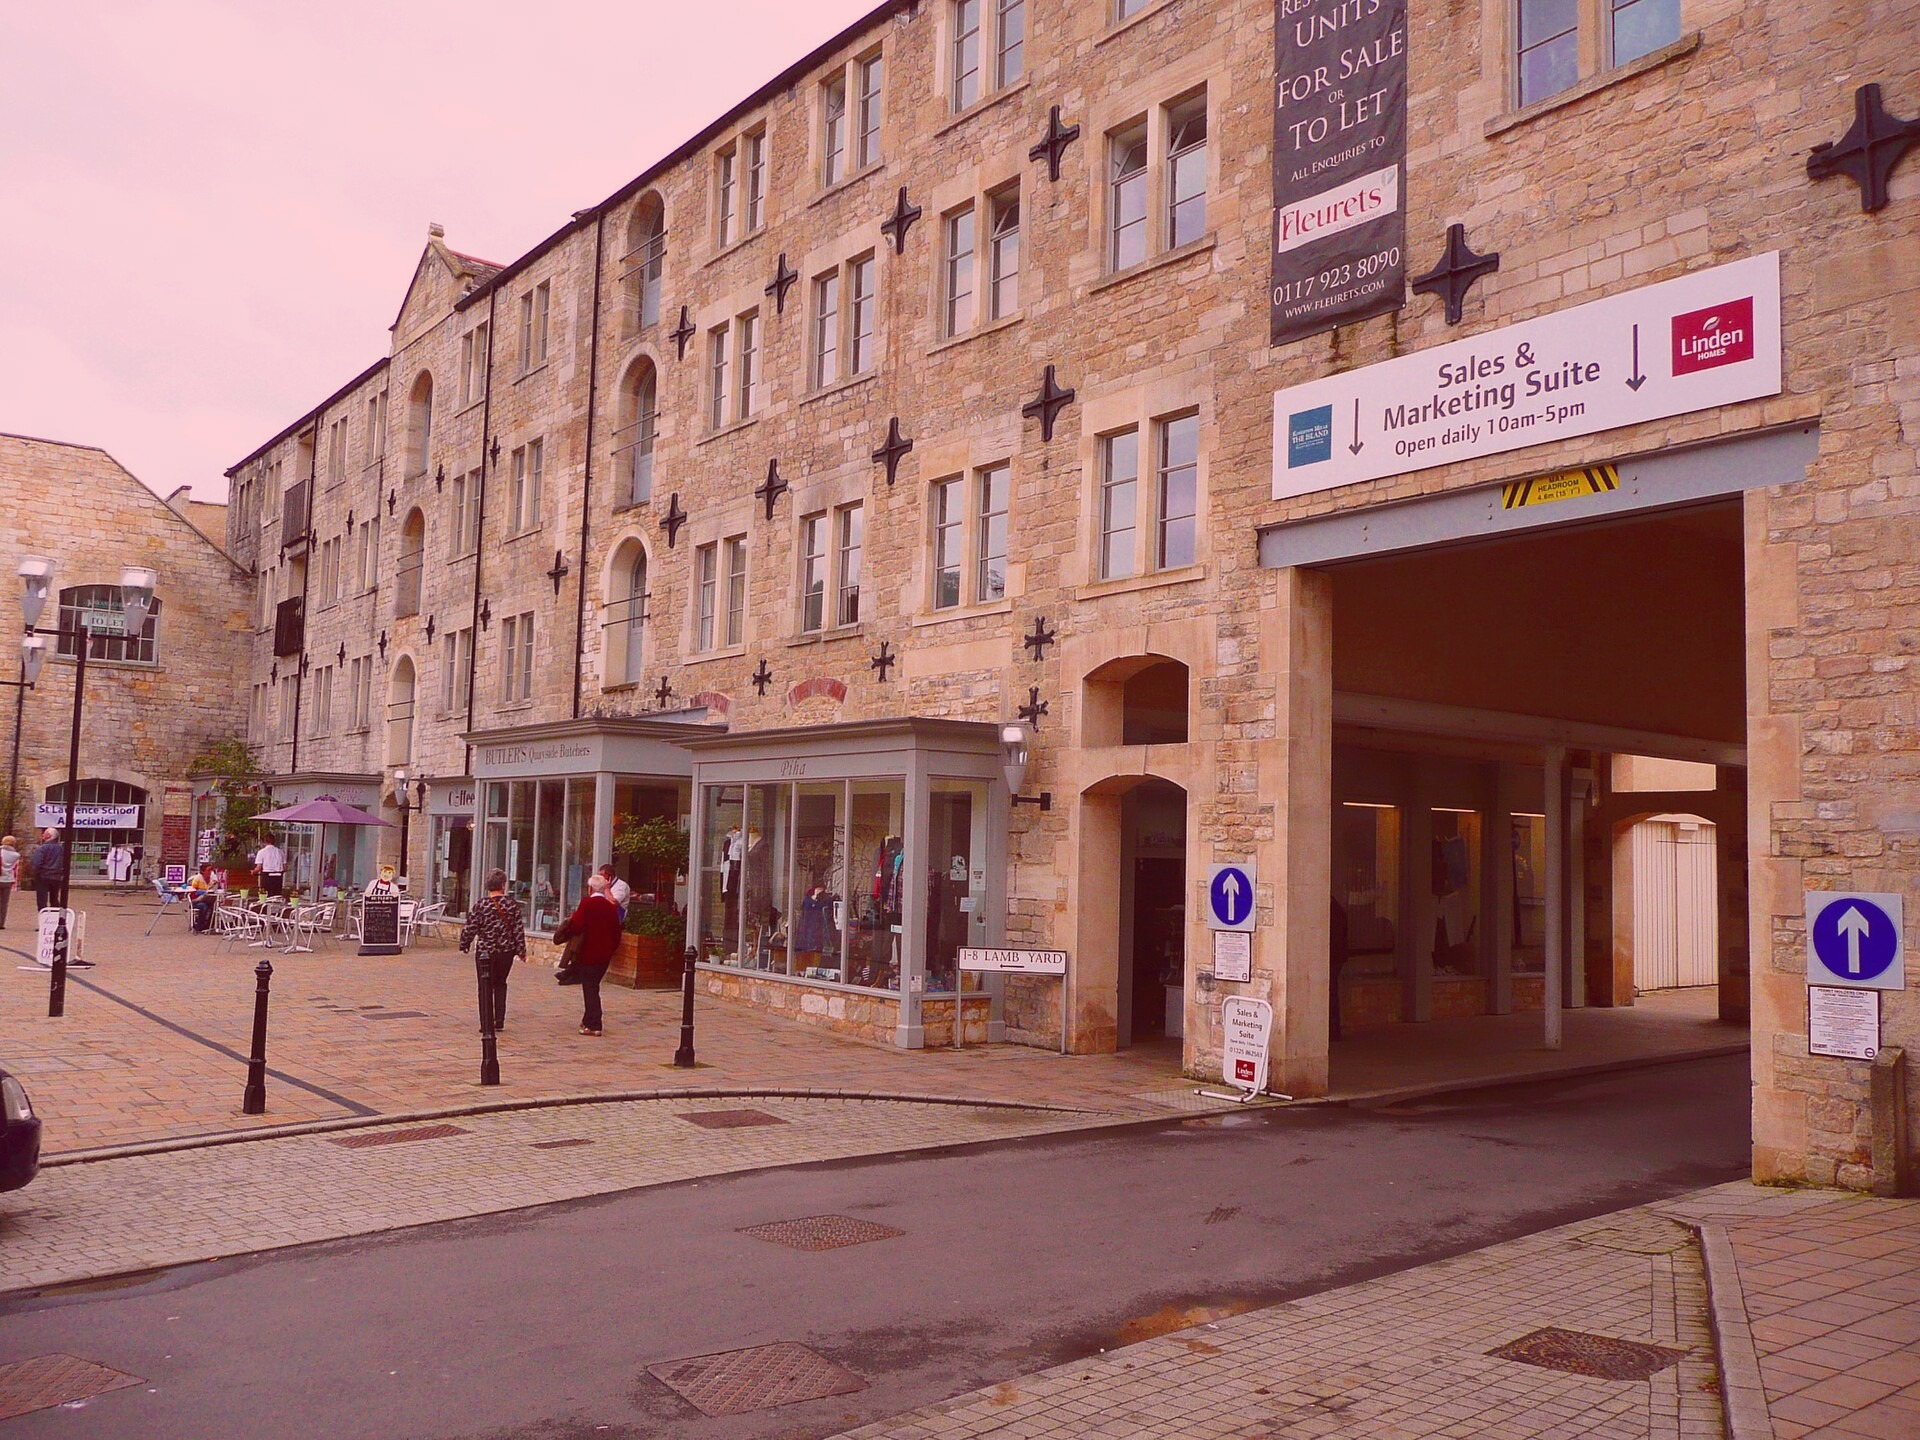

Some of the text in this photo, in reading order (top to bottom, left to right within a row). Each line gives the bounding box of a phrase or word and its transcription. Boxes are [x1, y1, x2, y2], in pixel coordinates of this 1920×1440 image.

[1296, 0, 1380, 47] UNITS
[1278, 29, 1403, 109] FOR SALE
[1328, 88, 1345, 104] OR
[1288, 88, 1387, 151] TO LET
[1290, 135, 1385, 182] ALL ENQUIRIES TO
[1282, 187, 1382, 241] Fleurets
[1273, 246, 1400, 306] 0117 923 8090
[1285, 279, 1386, 319] WWW.FLEURETS.COM
[1681, 329, 1743, 356] Linden
[1697, 347, 1727, 361] HOMES
[1438, 342, 1536, 389] Sales &
[1383, 361, 1600, 432] Marketing Suite
[1395, 402, 1585, 457] Open daily 10am-5pm
[1537, 479, 1579, 492] HEADROOM
[560, 743, 591, 758] Butchers
[39, 804, 136, 815] St Laence School
[448, 790, 475, 807] Coffee
[57, 816, 116, 826] Aociation
[984, 951, 1019, 962] LAMB
[1028, 952, 1063, 964] YARD
[1237, 1008, 1252, 1017] Sales
[1232, 1018, 1263, 1031] Marketing
[1239, 1030, 1255, 1039] Suite
